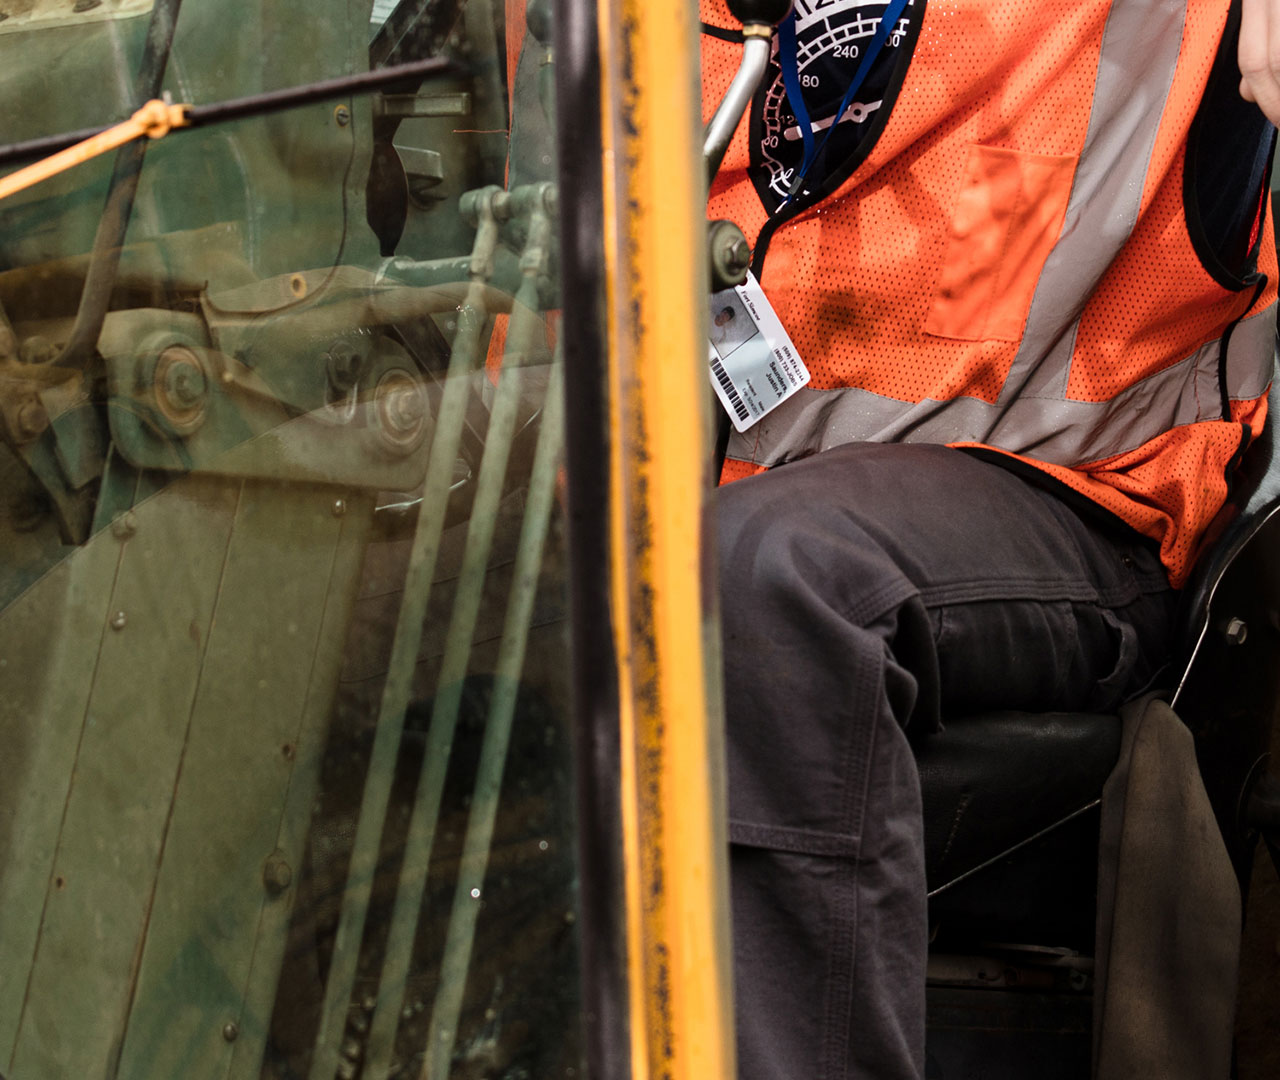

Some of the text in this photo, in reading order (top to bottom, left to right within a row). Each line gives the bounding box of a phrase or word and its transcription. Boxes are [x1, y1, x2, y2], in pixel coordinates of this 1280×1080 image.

[884, 35, 900, 48] 00
[832, 44, 859, 59] 240
[779, 114, 797, 126] 12
[766, 373, 778, 392] Justin
